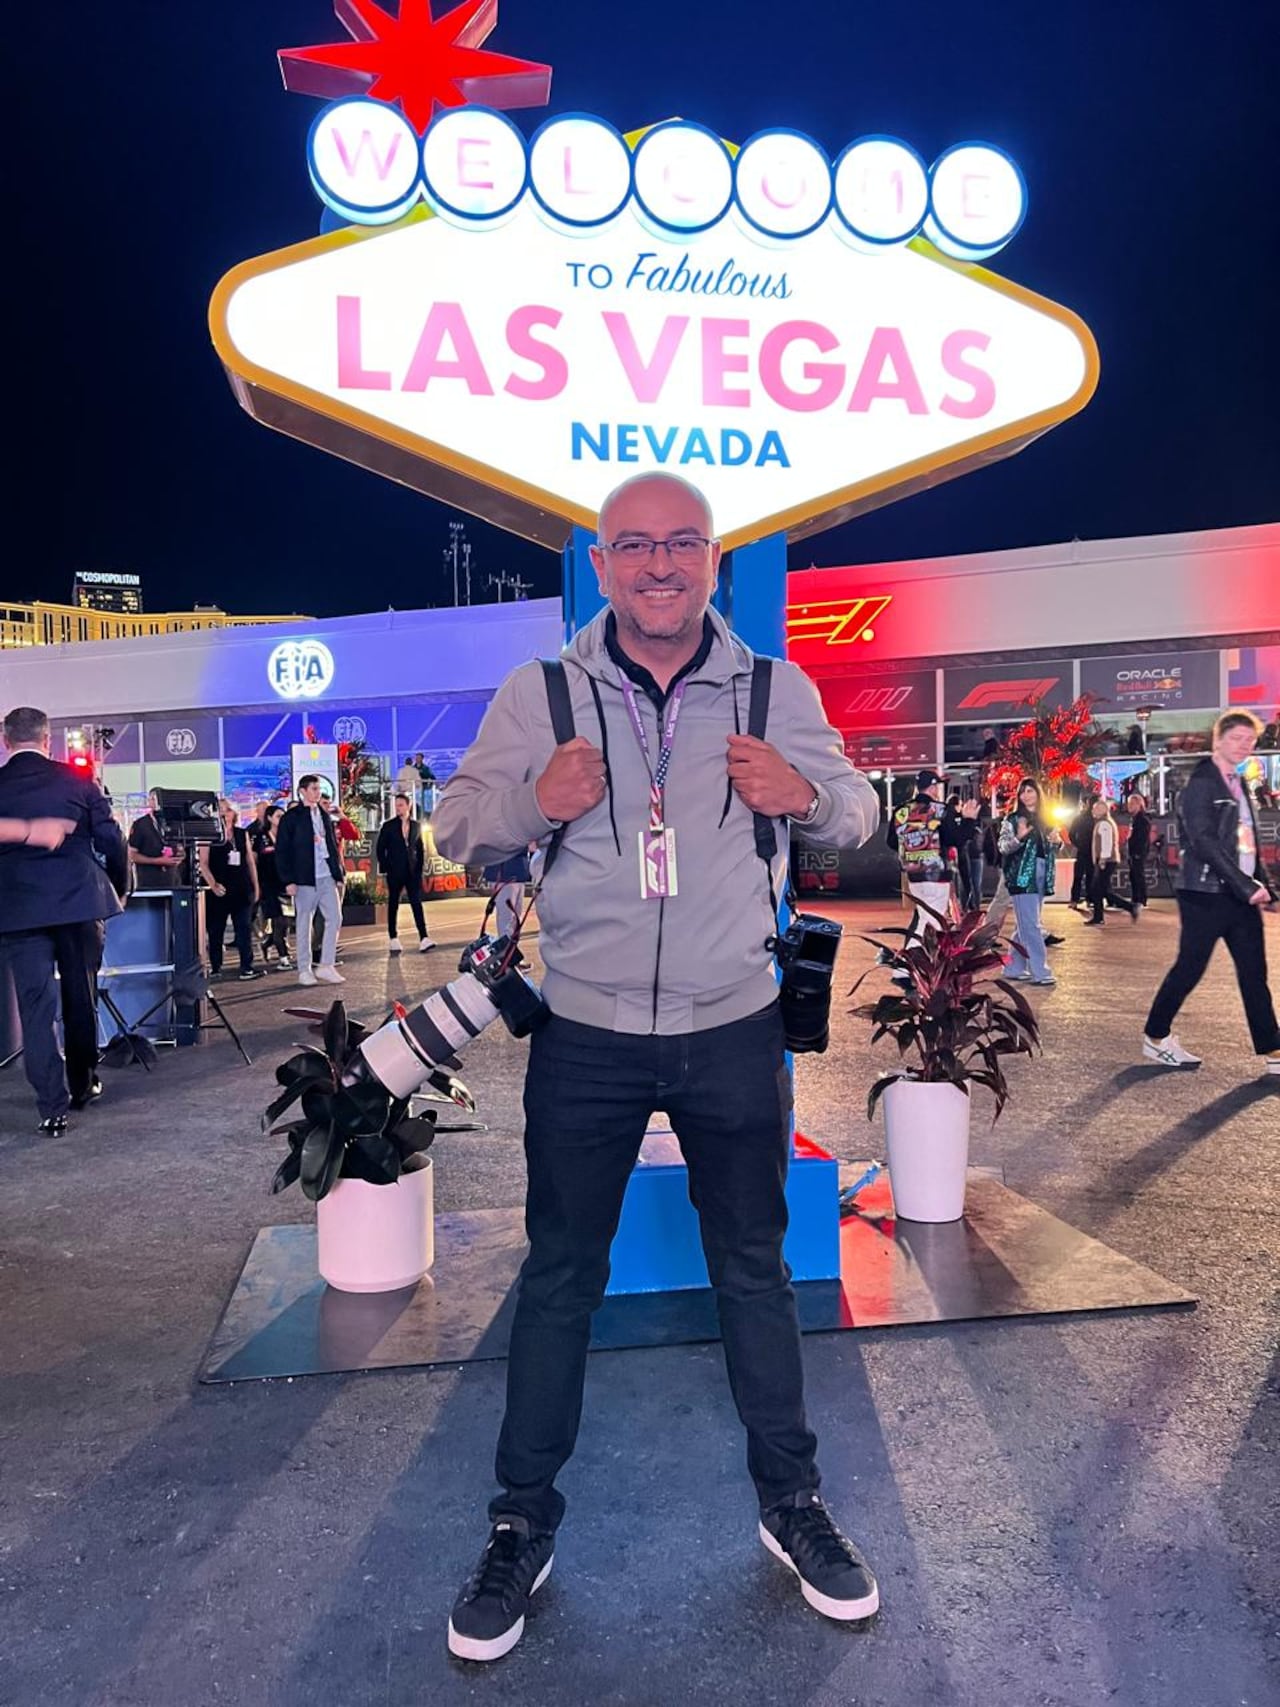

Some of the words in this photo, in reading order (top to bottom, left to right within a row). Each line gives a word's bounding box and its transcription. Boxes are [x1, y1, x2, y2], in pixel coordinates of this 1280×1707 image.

[328, 121, 995, 223] WELCOME
[566, 262, 613, 289] TO
[626, 252, 793, 301] Fabulous
[336, 294, 569, 401] LAS
[600, 311, 998, 420] VEGAS
[570, 421, 792, 468] NEVADA
[82, 572, 140, 585] COSMOPOLITAN
[1117, 667, 1182, 681] ORACLE
[1117, 691, 1182, 701] RACING
